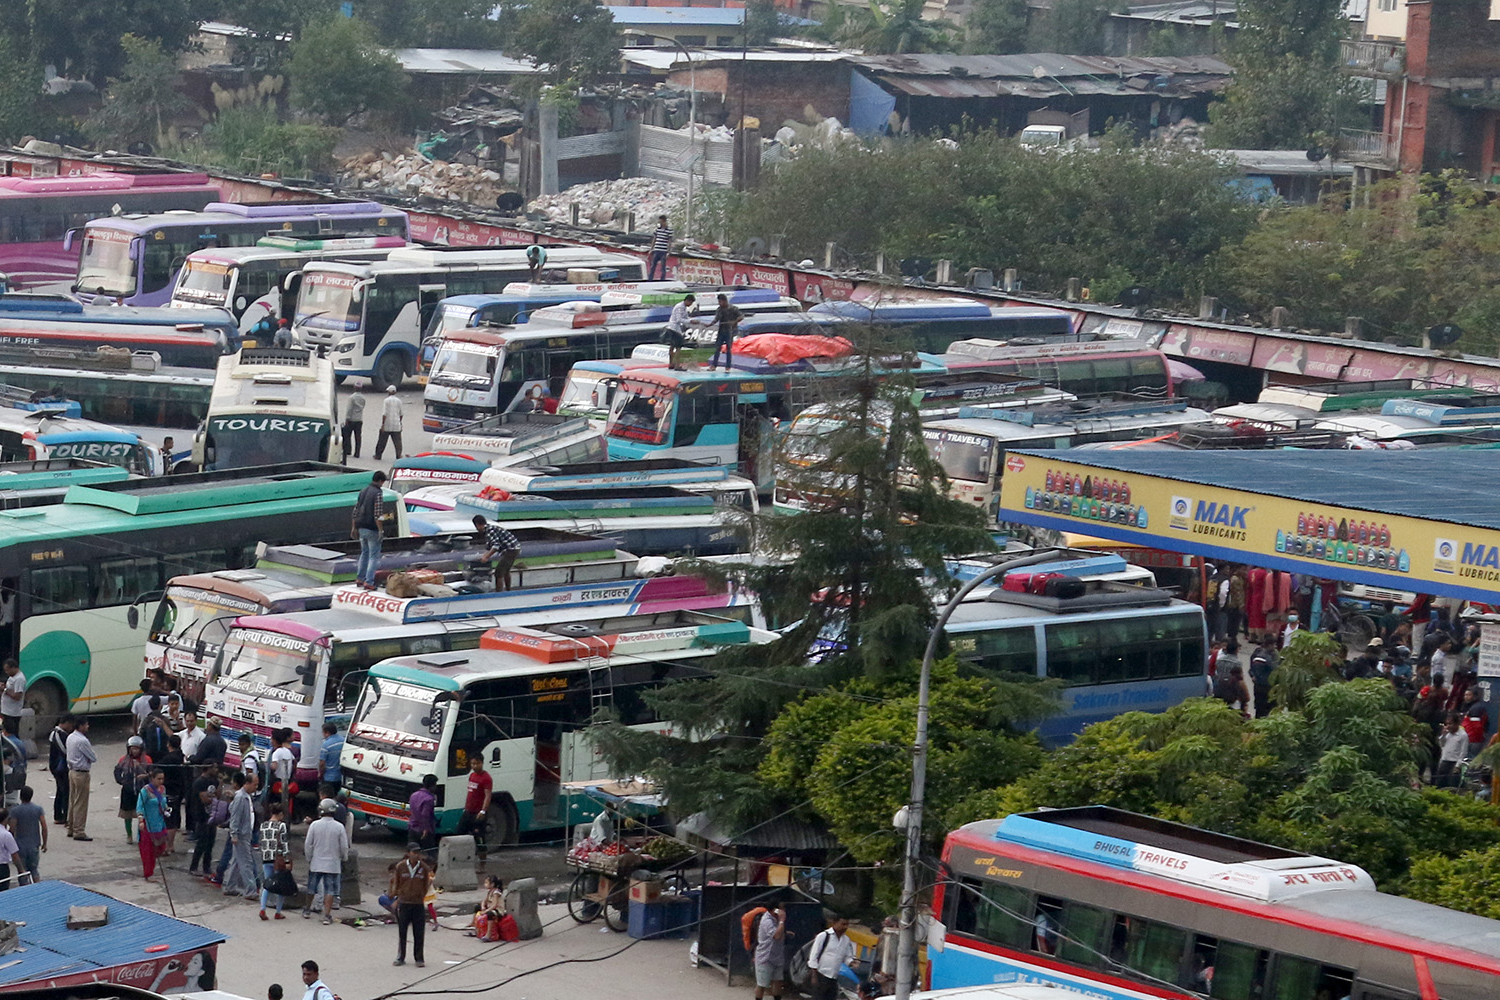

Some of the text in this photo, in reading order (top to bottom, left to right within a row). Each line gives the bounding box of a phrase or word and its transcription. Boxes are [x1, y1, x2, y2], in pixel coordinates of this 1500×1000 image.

[213, 417, 324, 434] TOURIST
[947, 433, 981, 445] TRAVELS
[49, 444, 132, 457] TOURIST
[1194, 500, 1250, 529] MAK
[1193, 524, 1247, 541] LUBRICANTS
[241, 710, 256, 720] TATA
[1093, 841, 1189, 870] BHUSAL TRAVELS
